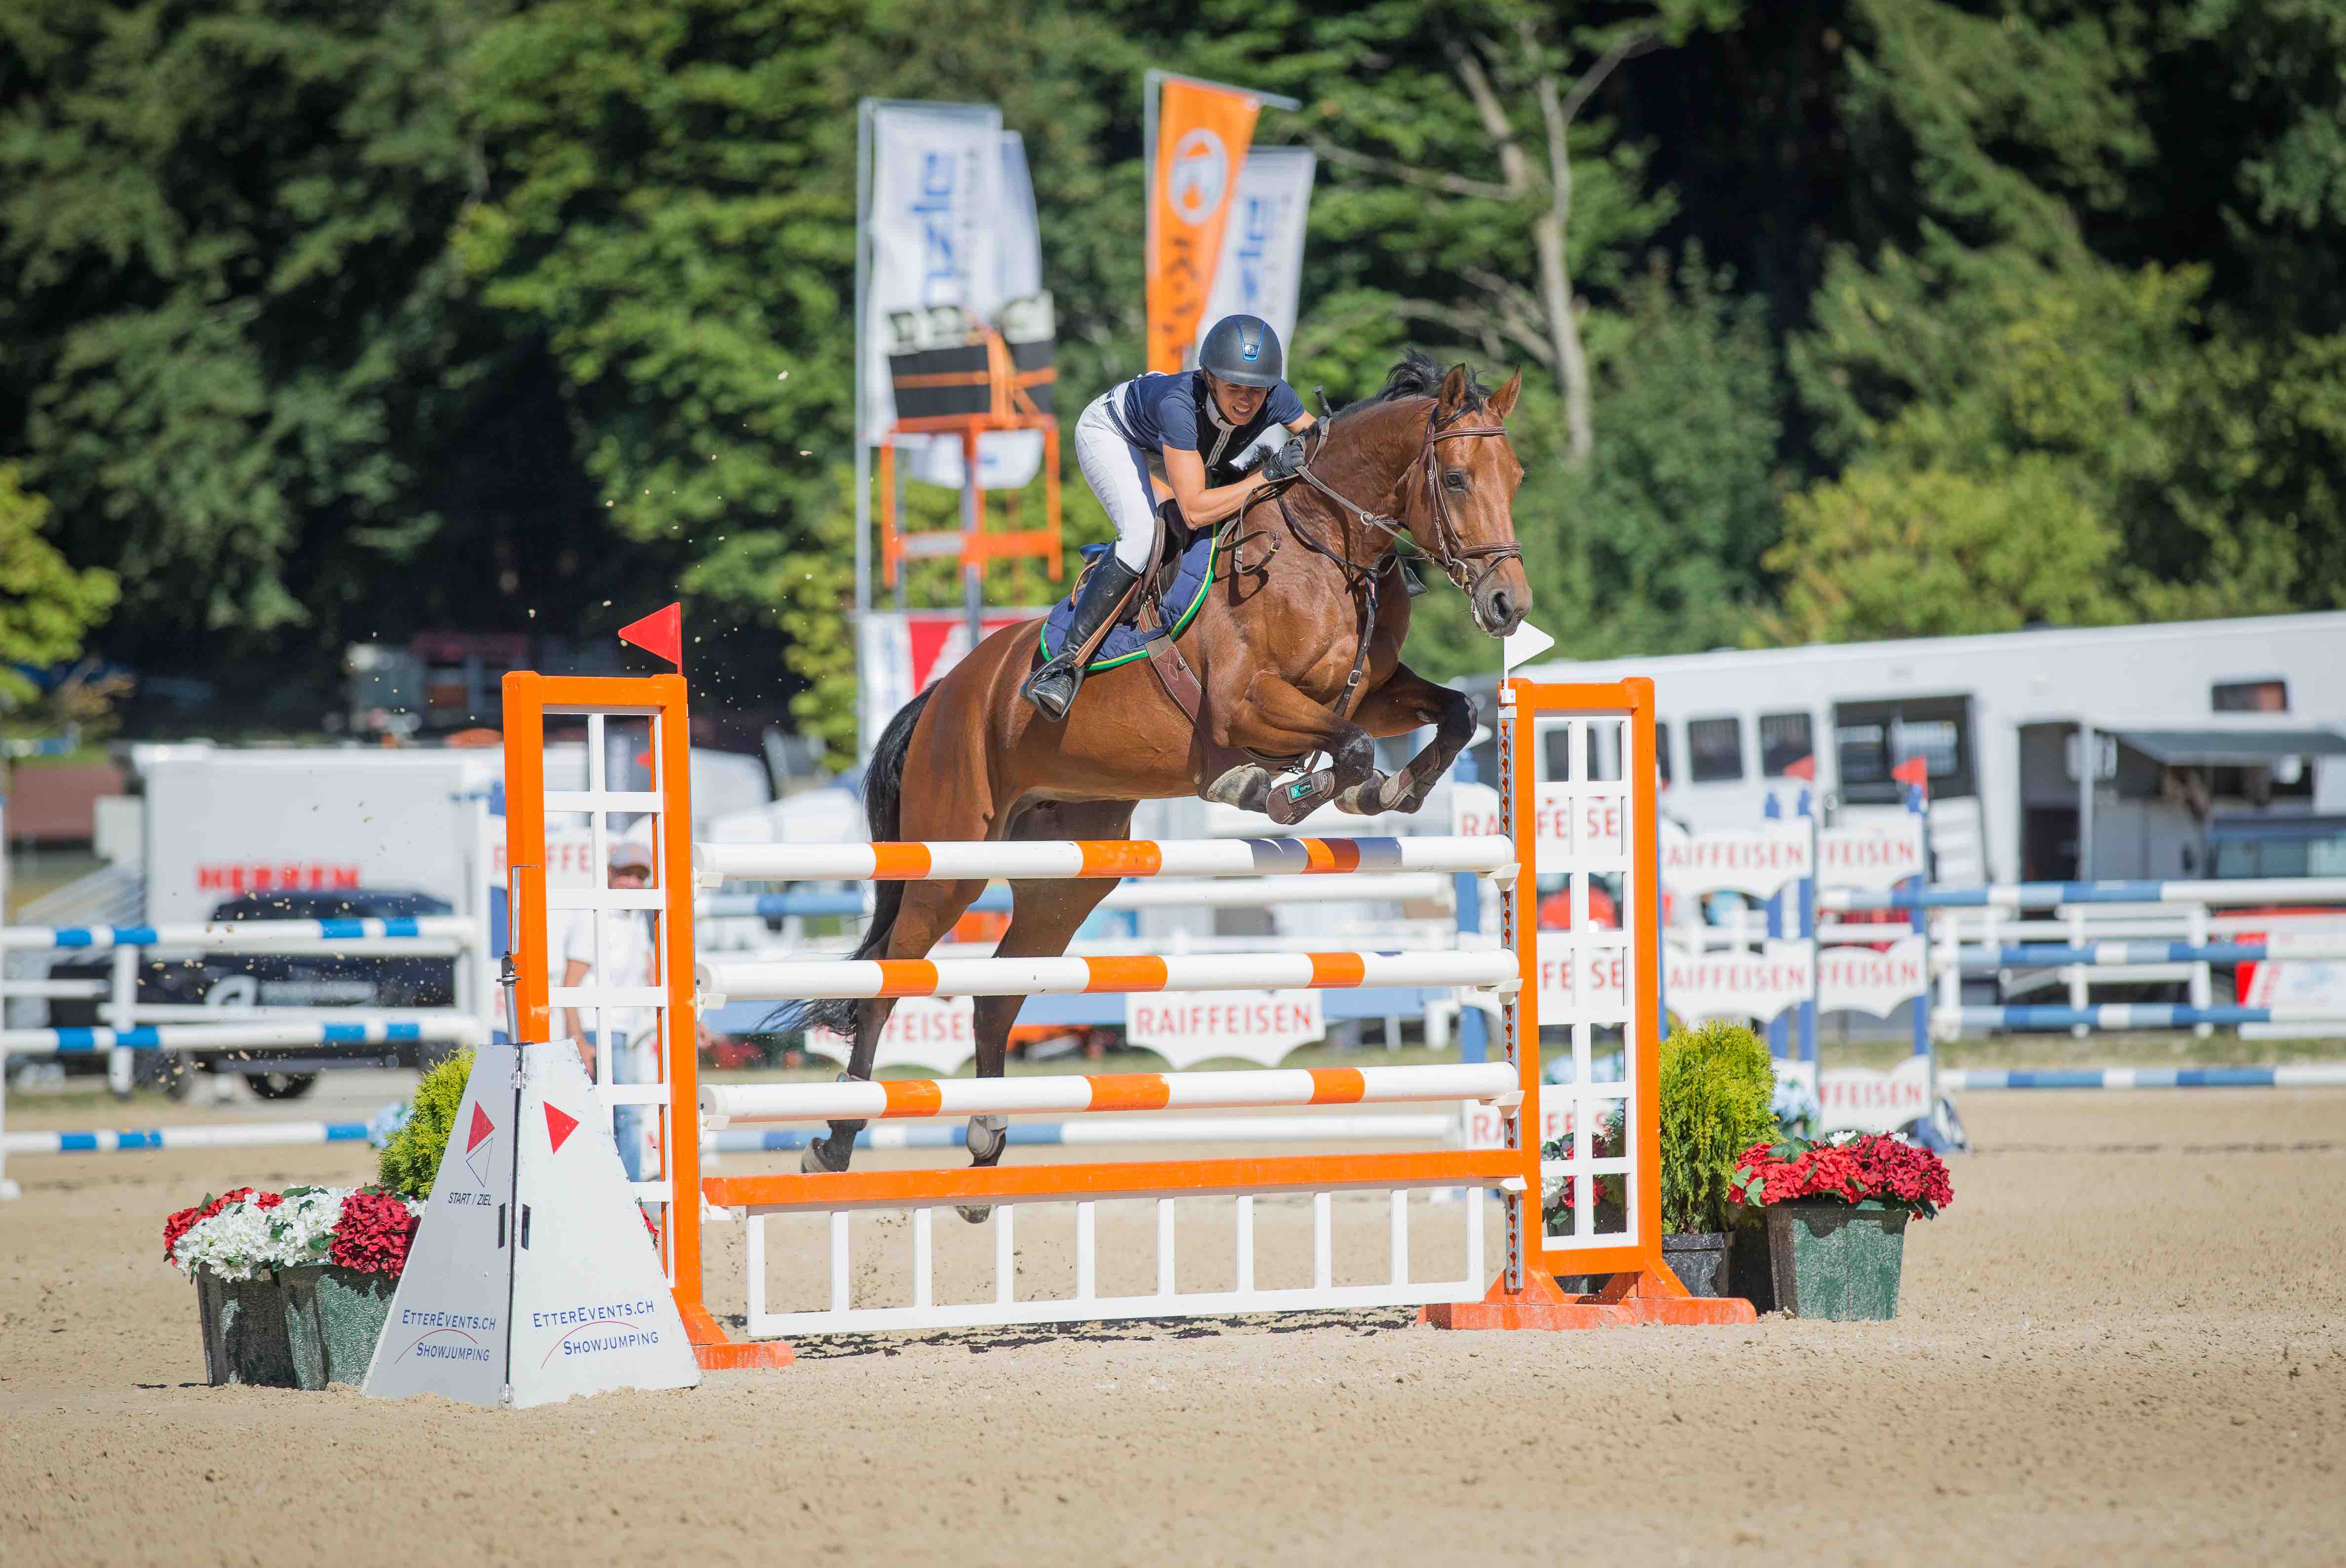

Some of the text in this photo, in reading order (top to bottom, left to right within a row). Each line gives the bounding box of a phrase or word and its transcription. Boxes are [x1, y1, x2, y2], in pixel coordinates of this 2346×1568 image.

[1136, 1003, 1312, 1035] RAIFFEISEN
[448, 1192, 491, 1205] START / ZIEL
